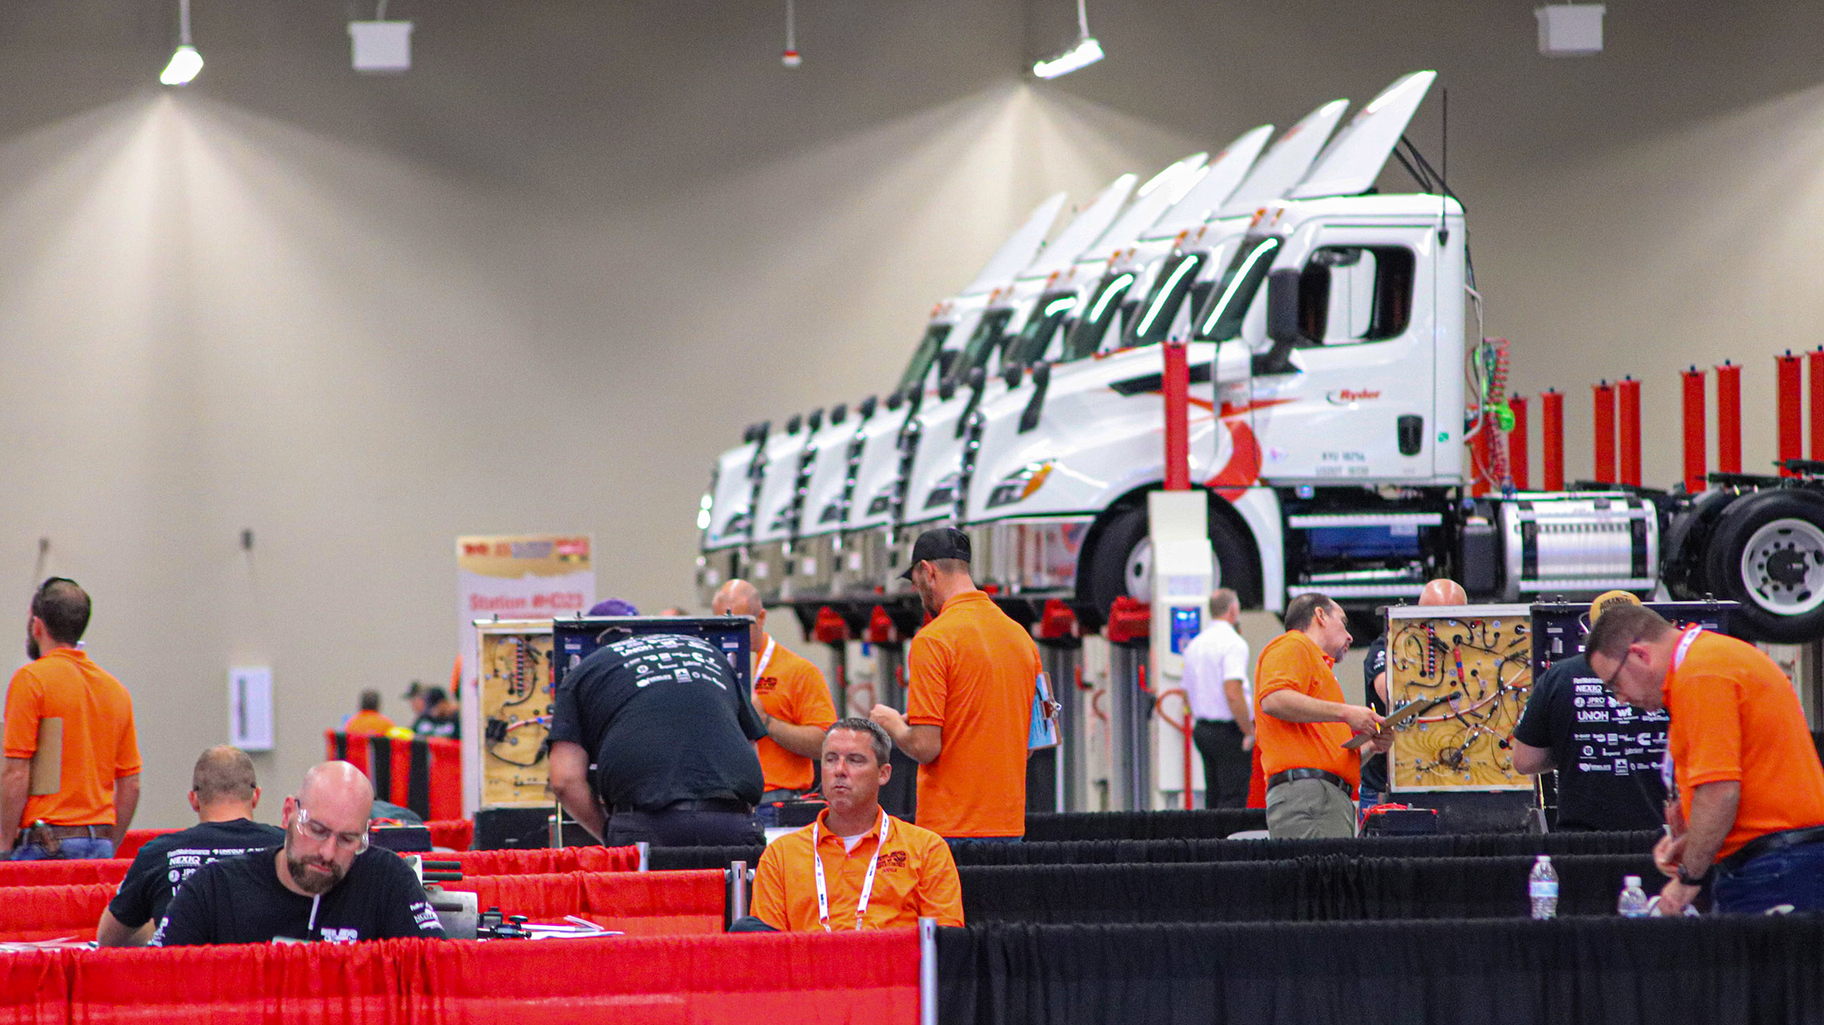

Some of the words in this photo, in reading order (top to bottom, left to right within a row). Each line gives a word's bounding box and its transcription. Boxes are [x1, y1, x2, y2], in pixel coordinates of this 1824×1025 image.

[1340, 389, 1381, 401] Ryder
[470, 593, 526, 610] Station
[1577, 711, 1609, 721] UNOH
[169, 856, 201, 866] NEXIQ
